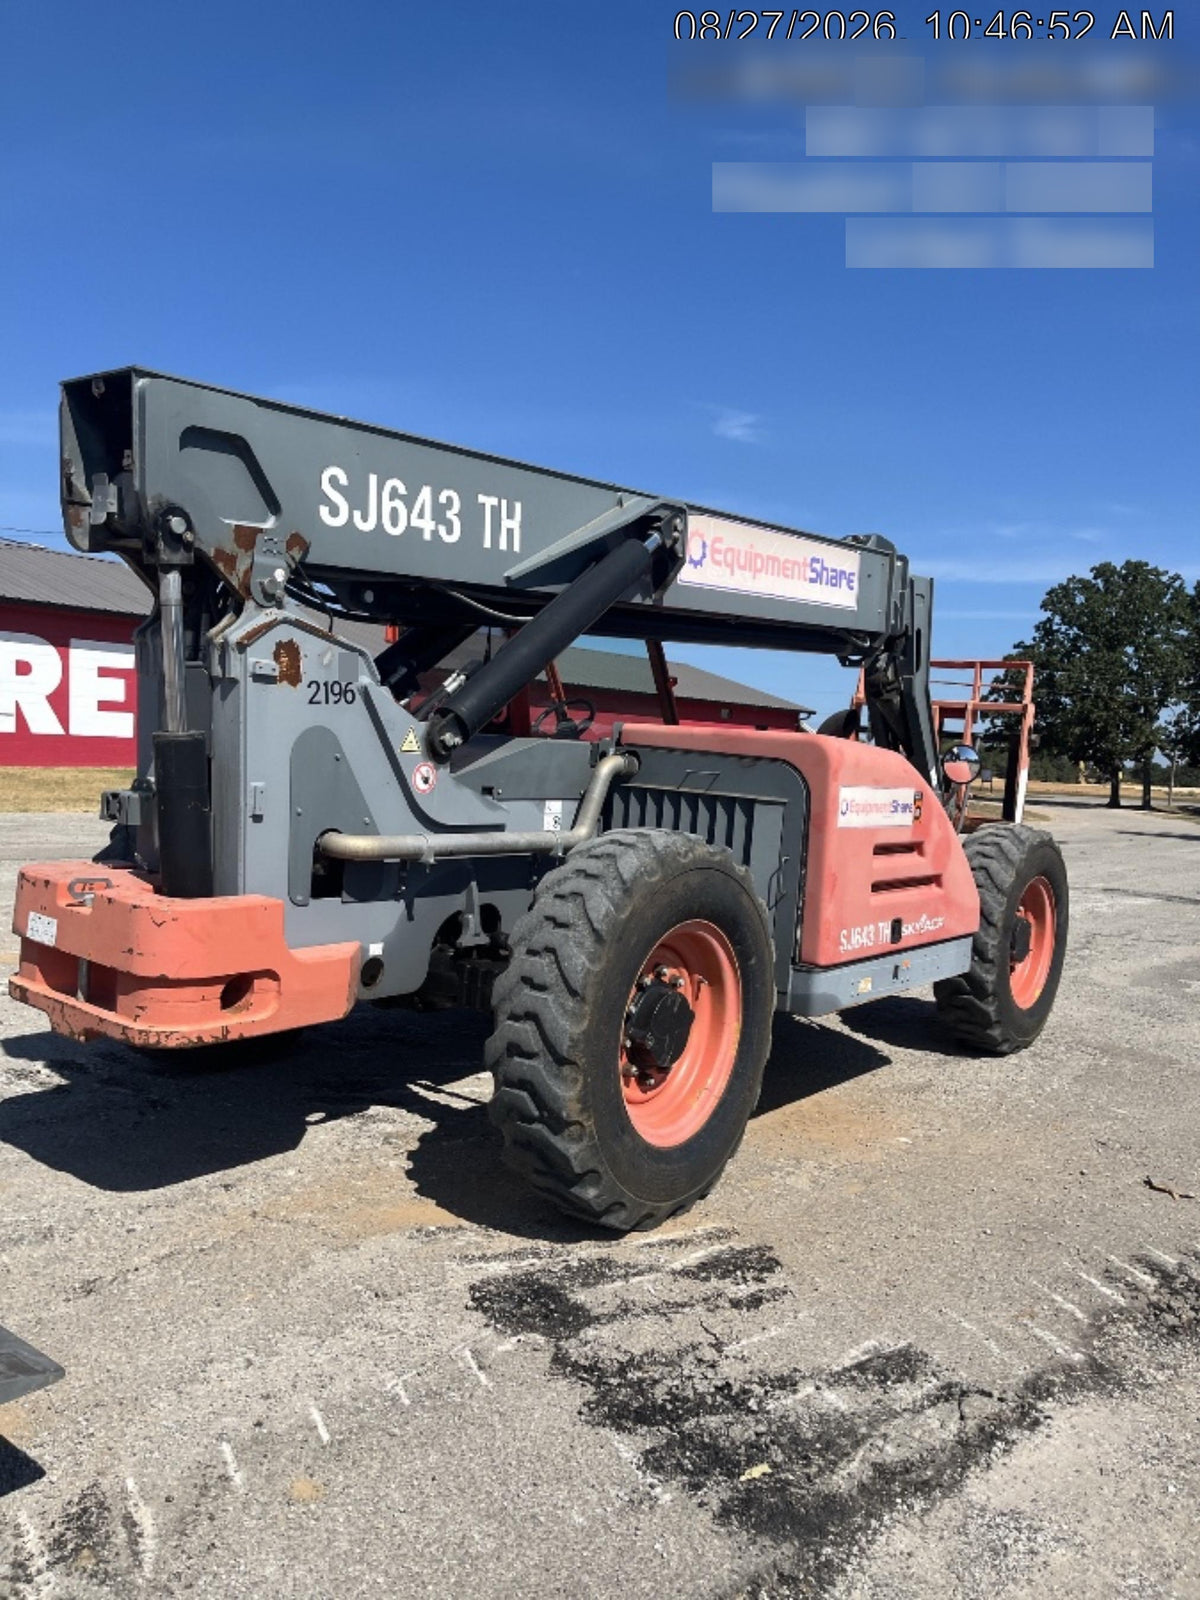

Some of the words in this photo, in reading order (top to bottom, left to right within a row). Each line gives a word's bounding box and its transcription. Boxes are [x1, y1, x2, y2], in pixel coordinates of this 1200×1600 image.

[319, 466, 462, 543] SJ643
[477, 493, 523, 552] TH
[710, 535, 856, 591] EquipmentShare
[307, 680, 356, 705] 2196
[840, 924, 875, 953] SJ643
[878, 921, 892, 944] TH
